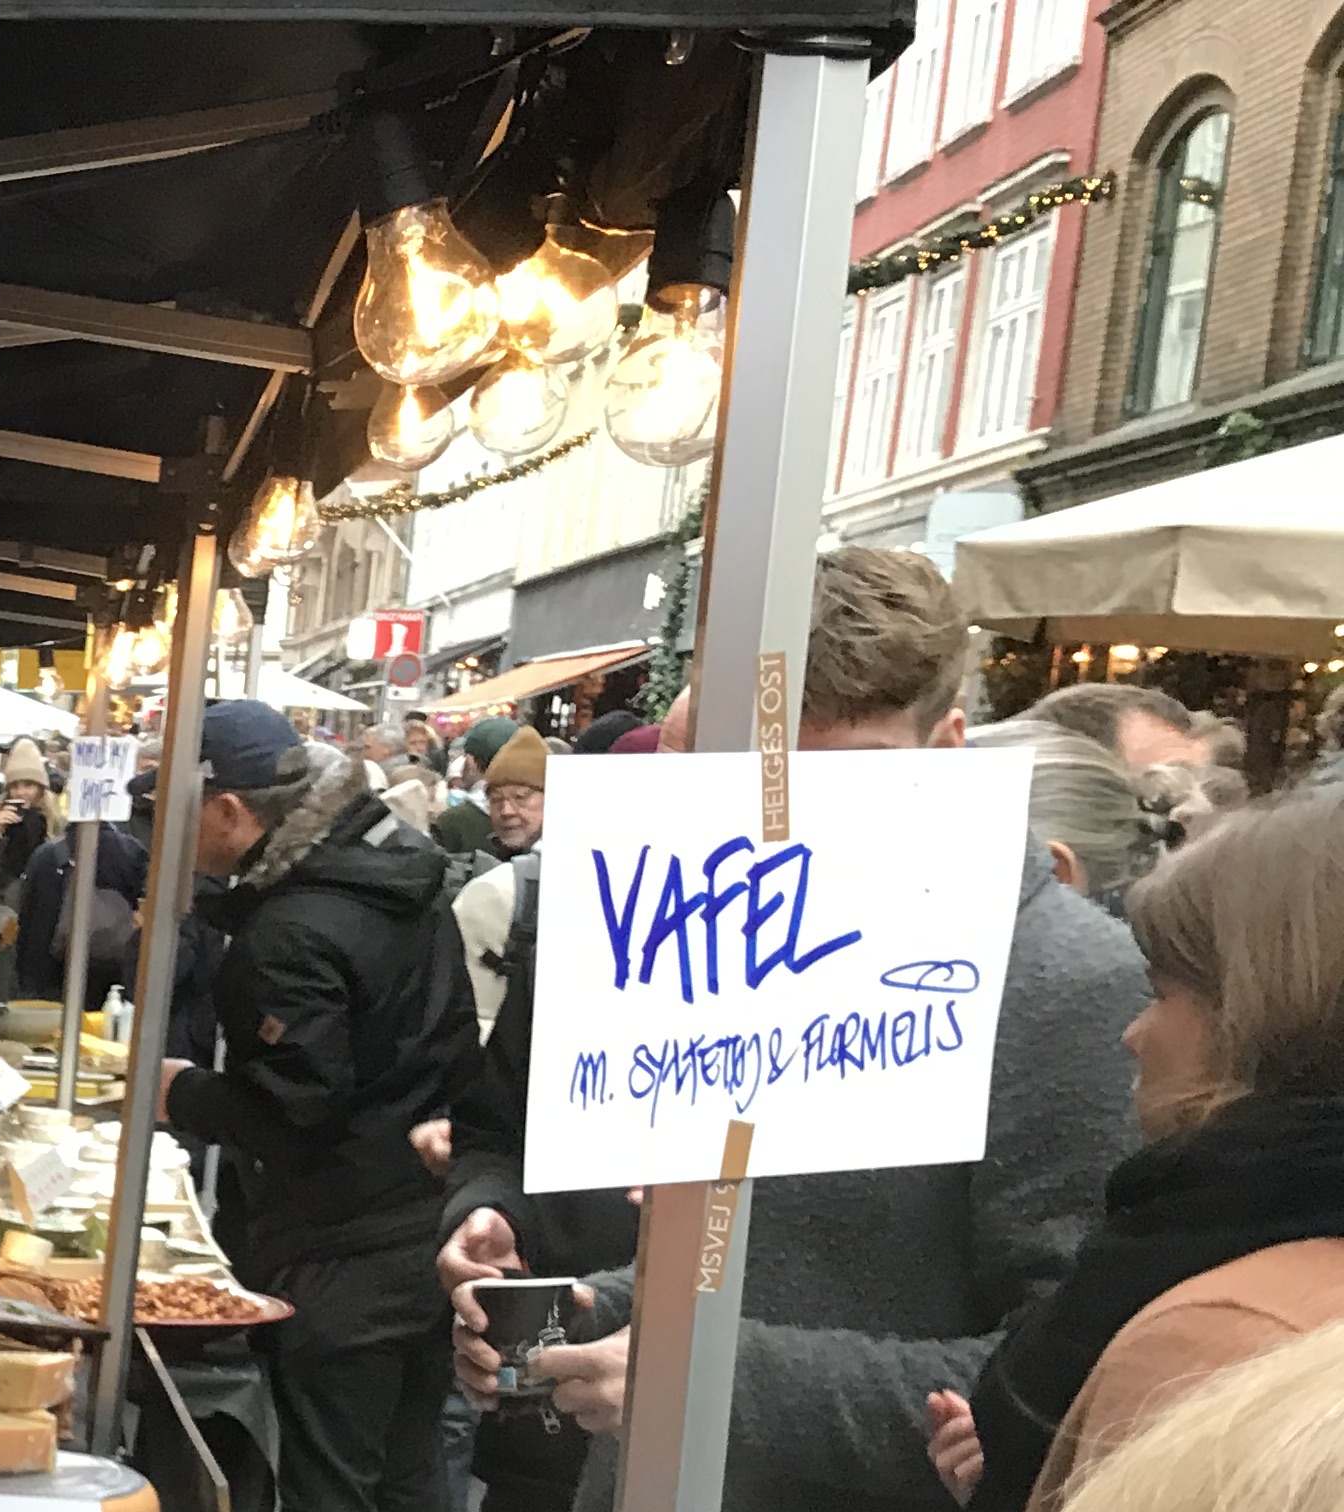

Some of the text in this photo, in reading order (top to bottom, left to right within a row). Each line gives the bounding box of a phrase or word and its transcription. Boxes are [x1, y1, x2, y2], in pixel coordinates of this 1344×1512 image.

[759, 656, 785, 831] HELGES OST
[591, 837, 863, 1003] VAFEL
